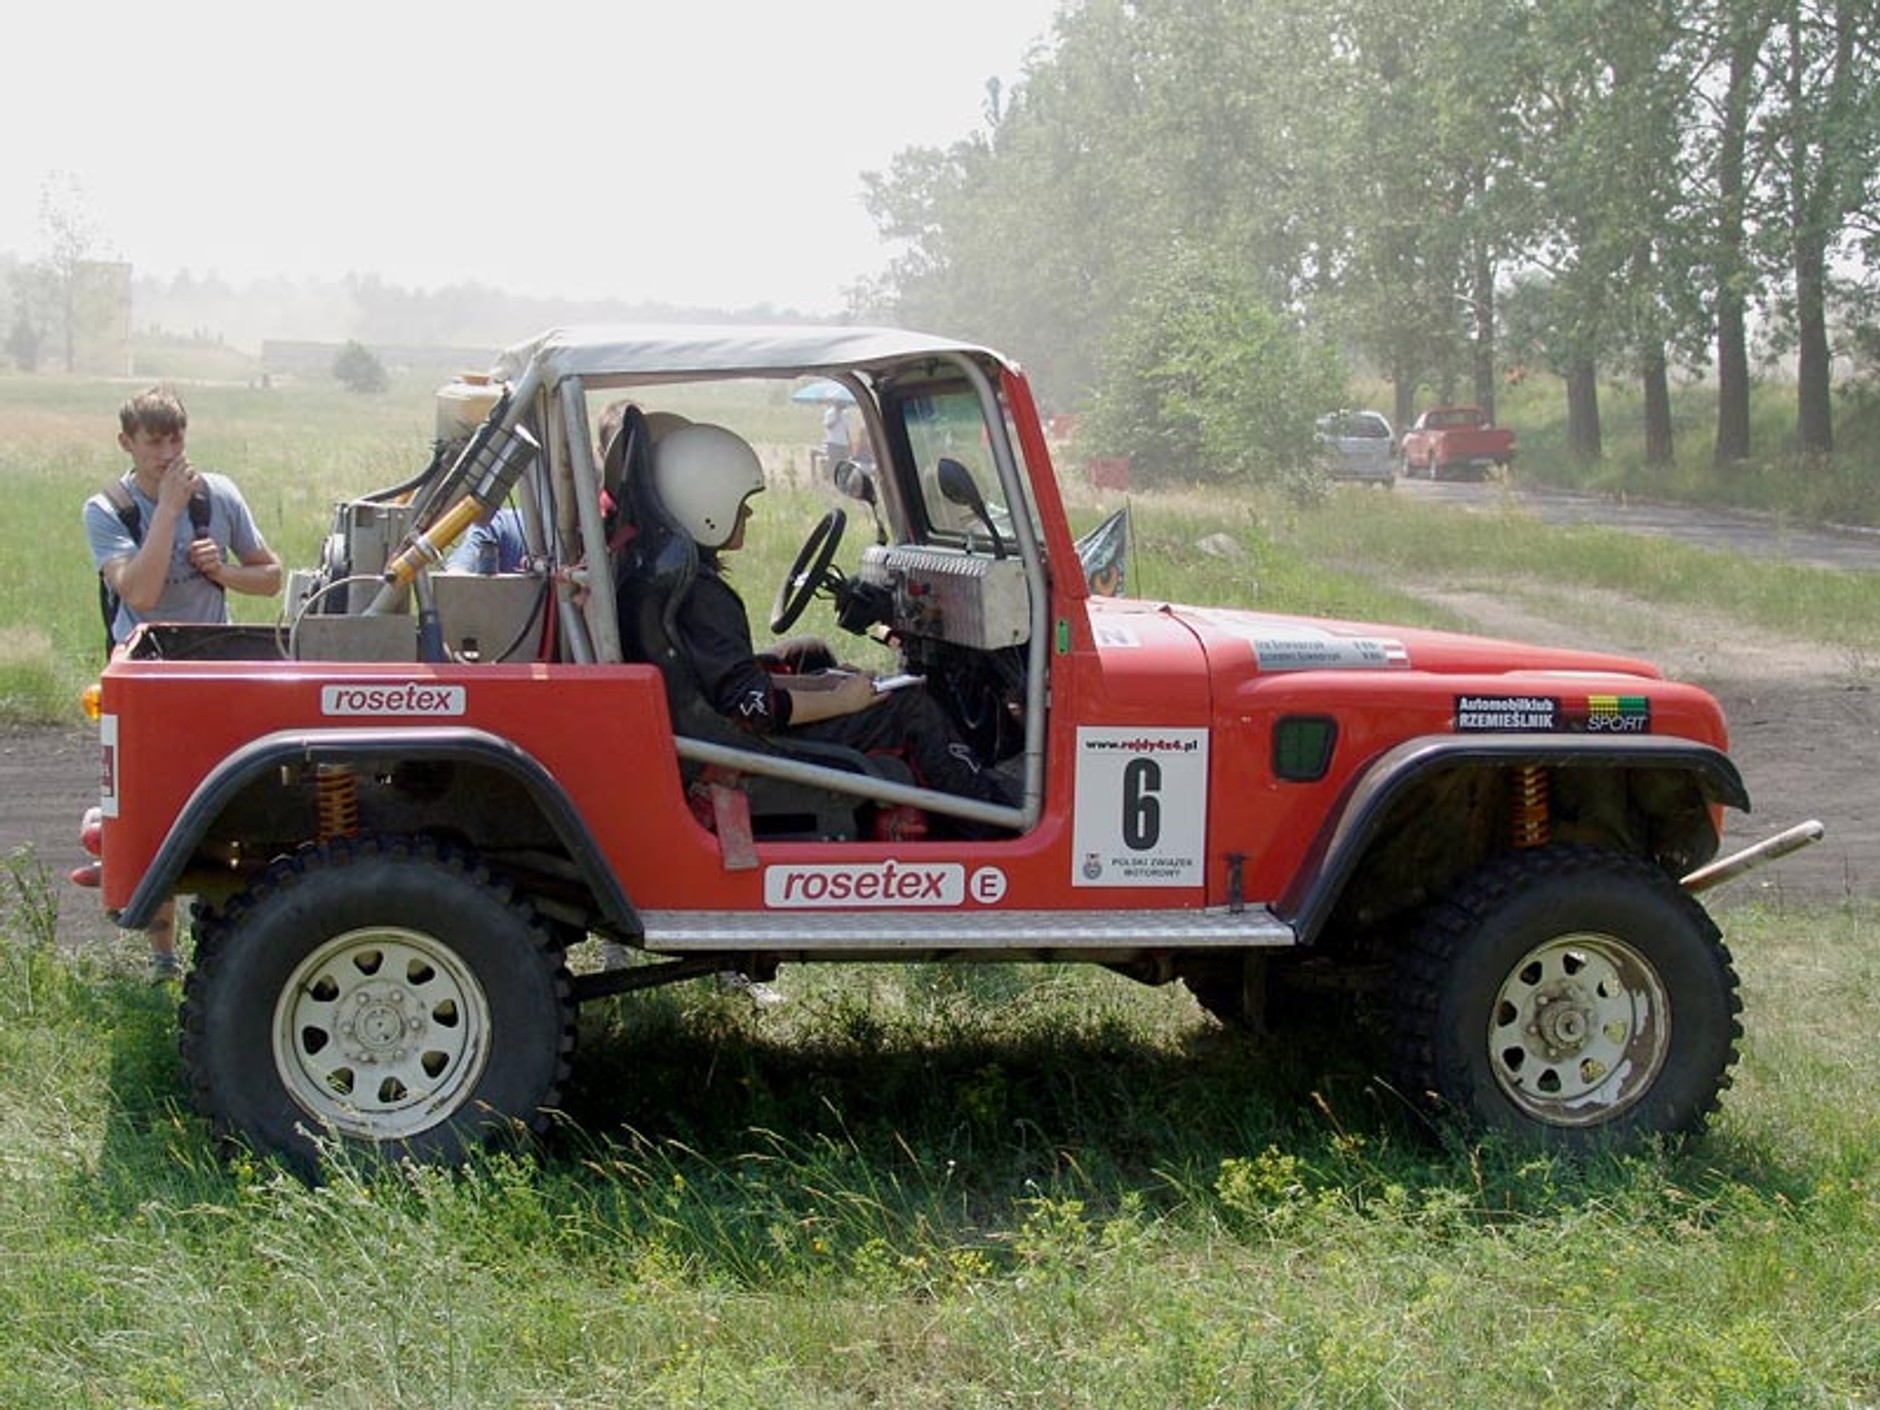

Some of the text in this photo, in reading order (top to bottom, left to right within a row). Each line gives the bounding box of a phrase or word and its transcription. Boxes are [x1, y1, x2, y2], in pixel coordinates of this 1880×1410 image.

[335, 685, 452, 711] rosetex
[1459, 696, 1554, 711] Automobilklub
[1587, 715, 1648, 731] SPORT
[1123, 757, 1162, 851] 6
[1111, 858, 1149, 867] POLSKI
[783, 863, 947, 900] rosetex
[979, 874, 998, 897] E
